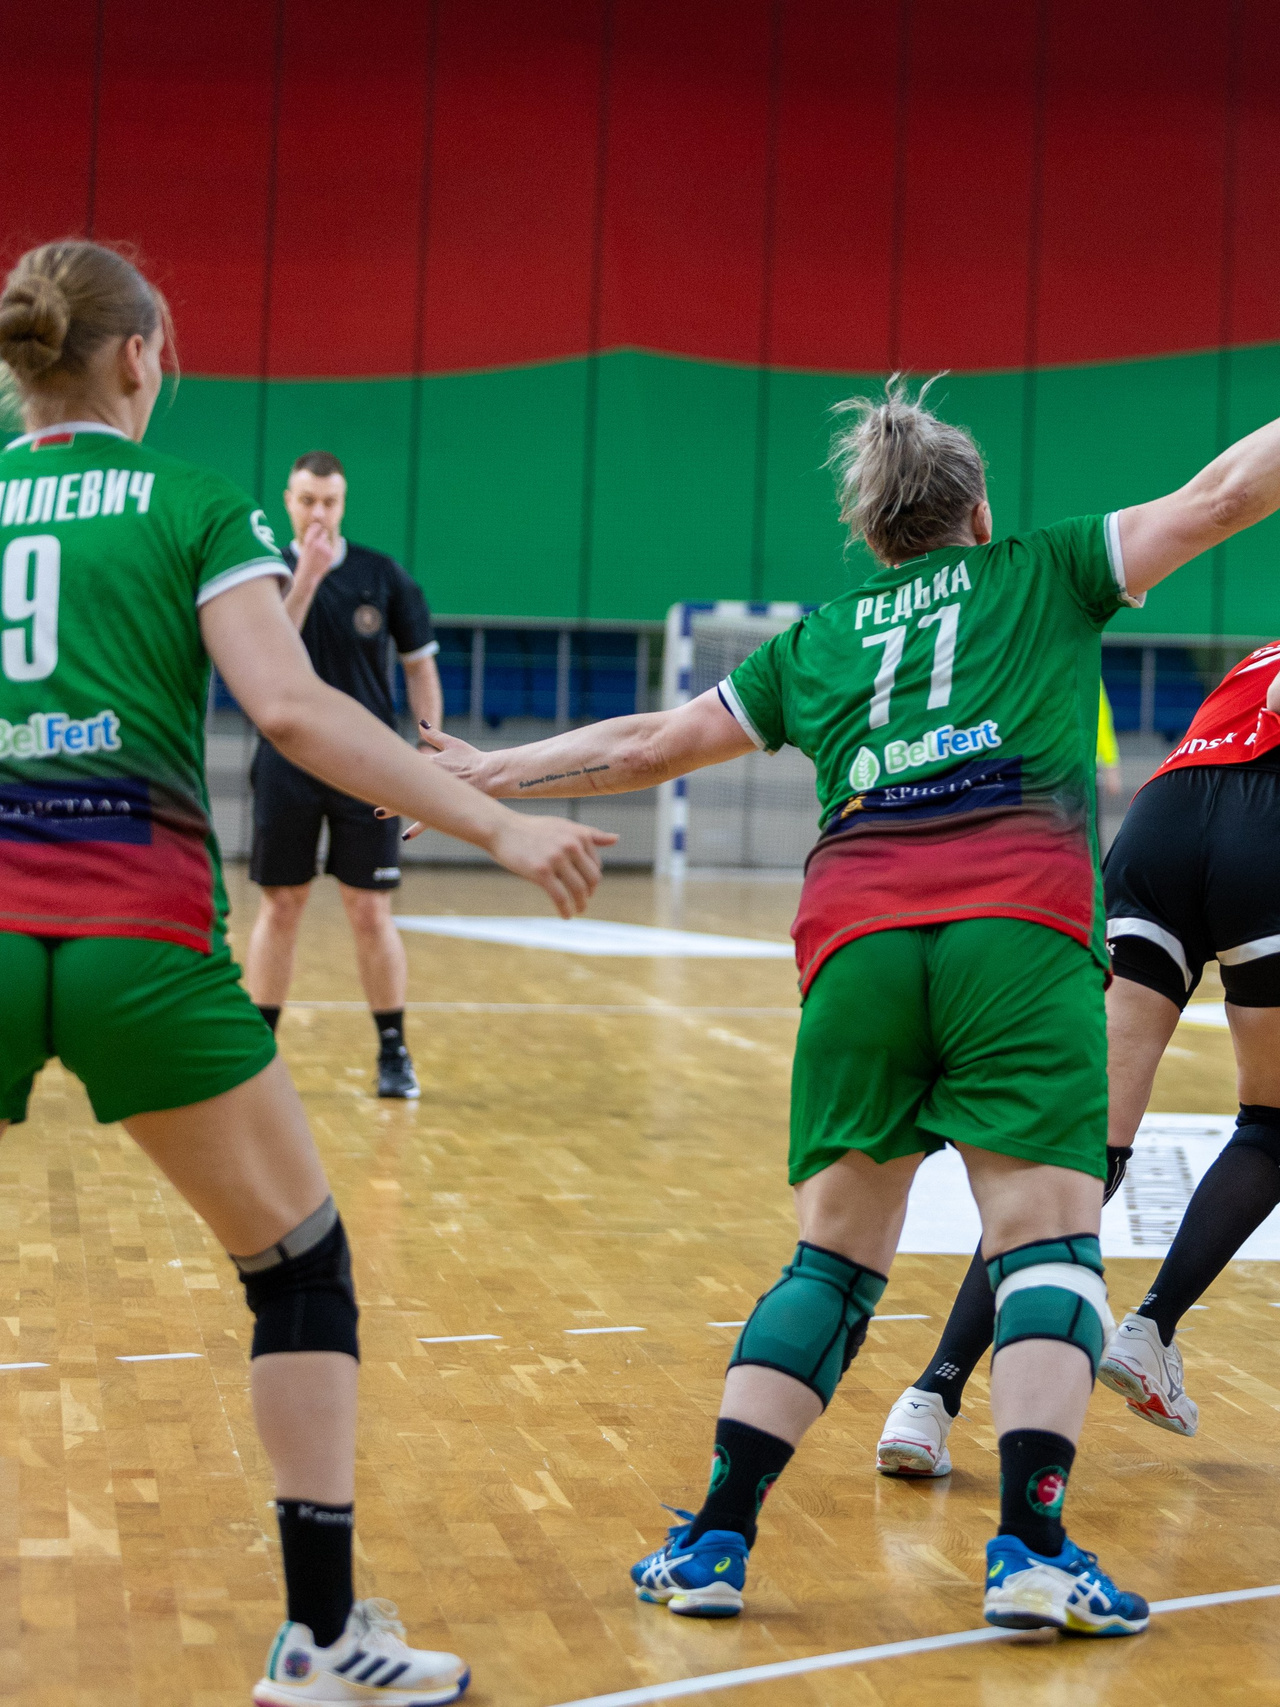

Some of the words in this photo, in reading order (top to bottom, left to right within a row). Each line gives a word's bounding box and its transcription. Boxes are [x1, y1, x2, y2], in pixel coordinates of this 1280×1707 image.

[0, 468, 155, 527] ИЛЕВИЧ
[1, 534, 61, 682] 9
[854, 559, 972, 631] РЕДЬКА
[886, 721, 1001, 773] BelFert
